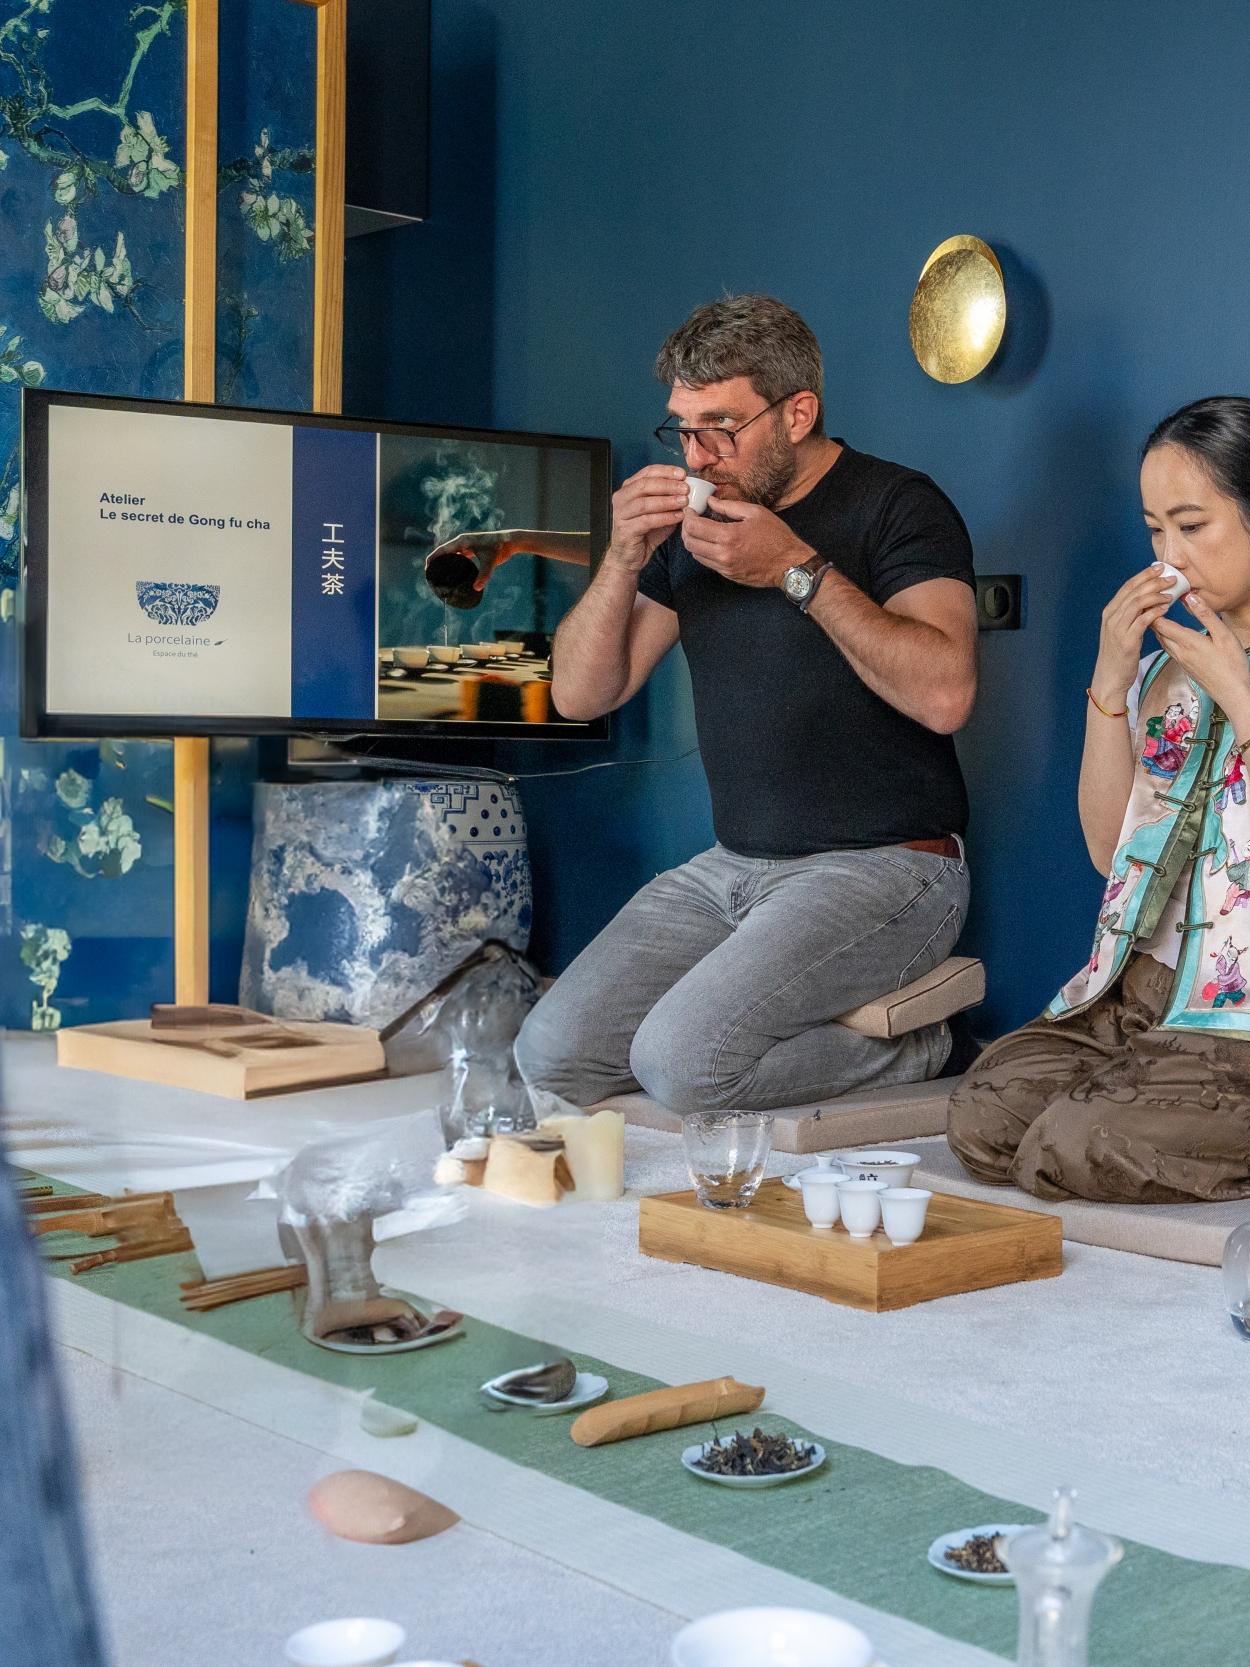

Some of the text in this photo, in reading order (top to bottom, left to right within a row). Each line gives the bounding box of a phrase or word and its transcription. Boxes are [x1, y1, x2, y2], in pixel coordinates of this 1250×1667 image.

[100, 492, 146, 506] Atelier
[100, 508, 271, 530] Le secret de Gong fu cha
[321, 523, 345, 596] 工夫茶
[127, 632, 211, 647] La porcelaine
[152, 650, 177, 658] Espace
[177, 650, 186, 658] du
